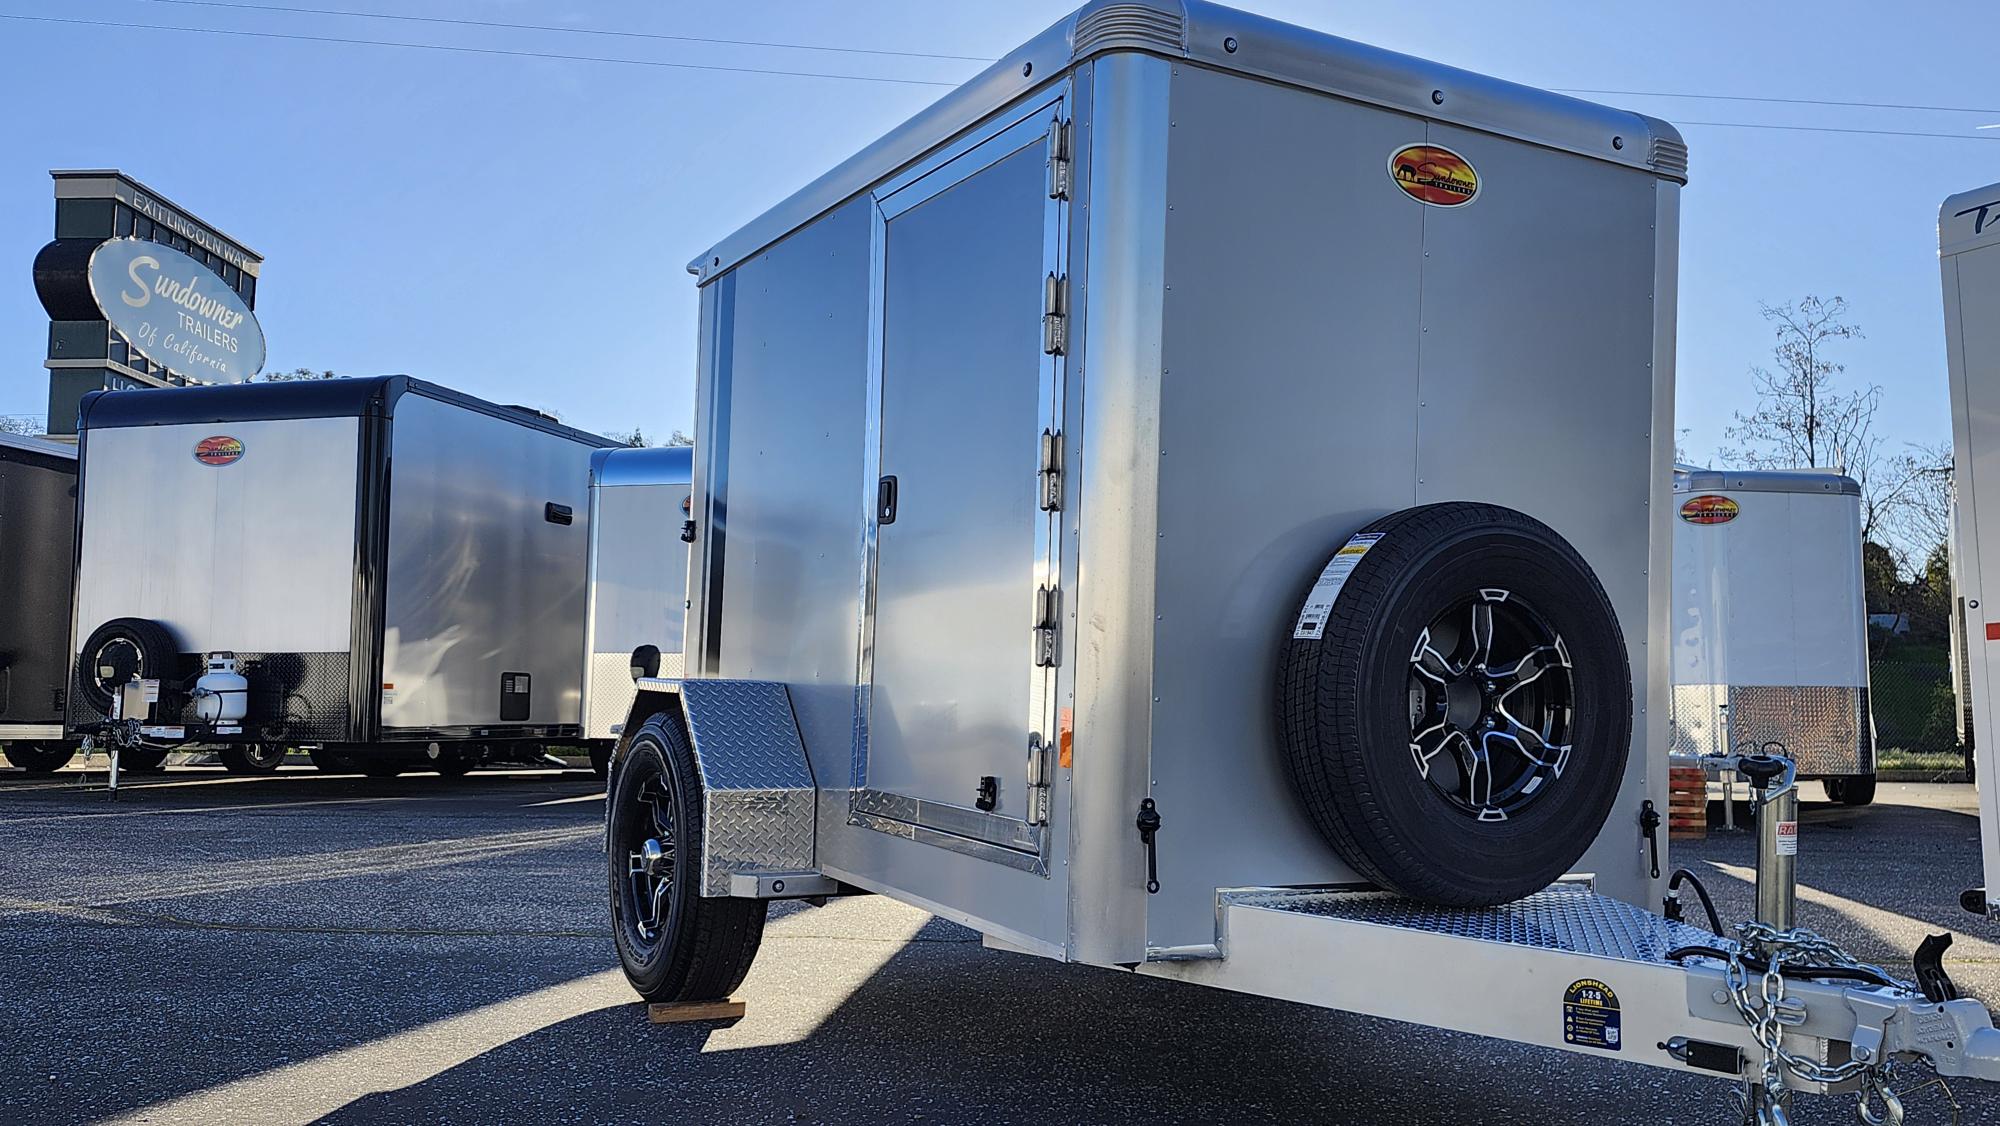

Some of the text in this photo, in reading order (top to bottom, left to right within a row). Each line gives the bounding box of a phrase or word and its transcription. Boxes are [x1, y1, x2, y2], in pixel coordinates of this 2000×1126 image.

[1417, 162, 1475, 189] Sundowner
[133, 190, 248, 269] EXIT LINCOLN WAY
[121, 255, 243, 330] Sundowner
[138, 321, 227, 373] Of California
[178, 311, 238, 353] TRAILERS
[1569, 980, 1614, 998] LIONSHEAD
[1580, 998, 1603, 1007] LIFETIME
